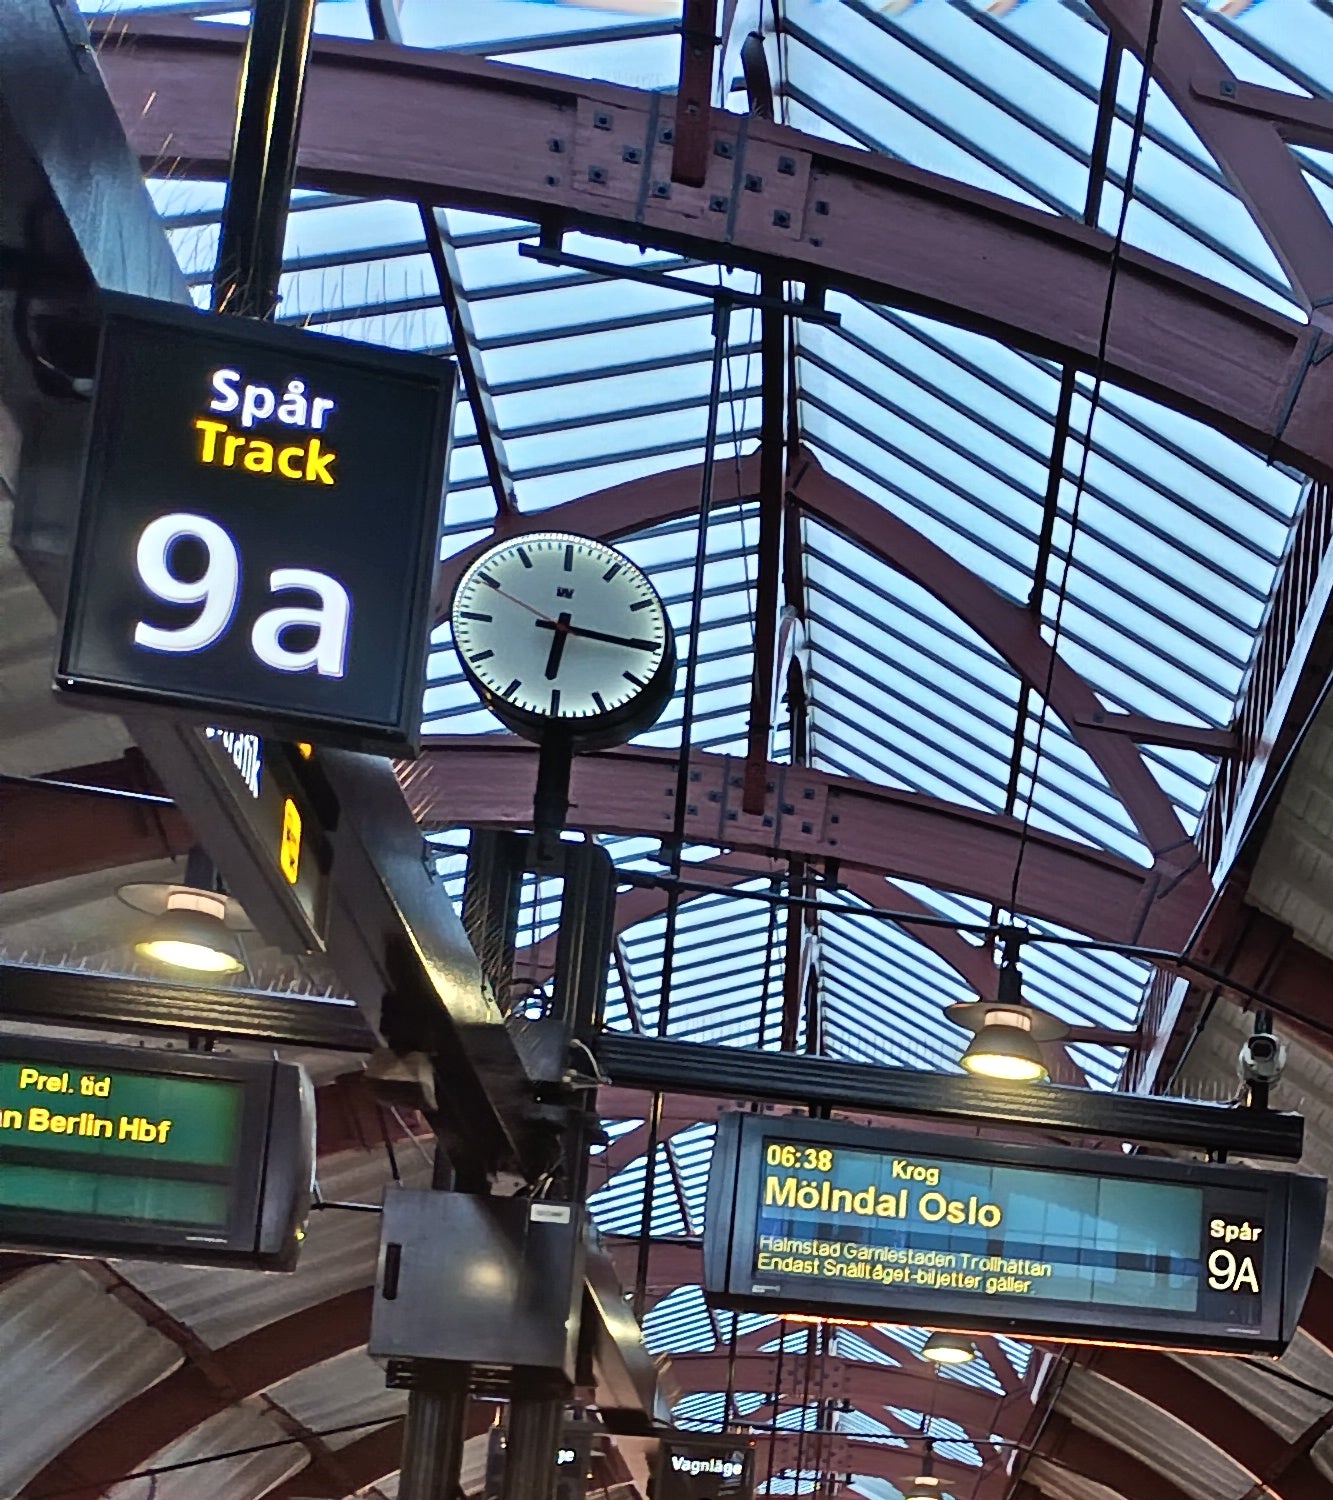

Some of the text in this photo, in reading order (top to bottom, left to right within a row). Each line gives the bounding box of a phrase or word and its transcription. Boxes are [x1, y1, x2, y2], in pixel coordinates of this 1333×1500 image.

[210, 368, 335, 429] Spår
[195, 419, 336, 486] Track
[134, 512, 351, 679] 9a
[20, 1068, 112, 1098] Prel. tid
[28, 1107, 113, 1138] Berlin
[118, 1116, 172, 1144] Hbf
[766, 1145, 941, 1186] 06:38 Krog
[765, 1176, 1002, 1228] Mölndal Oslo
[759, 1234, 842, 1258] Halmstad
[1210, 1219, 1263, 1243] Spår
[757, 1252, 820, 1275] Endast
[1208, 1249, 1260, 1293] 9A
[672, 1456, 743, 1478] Vagnläge
